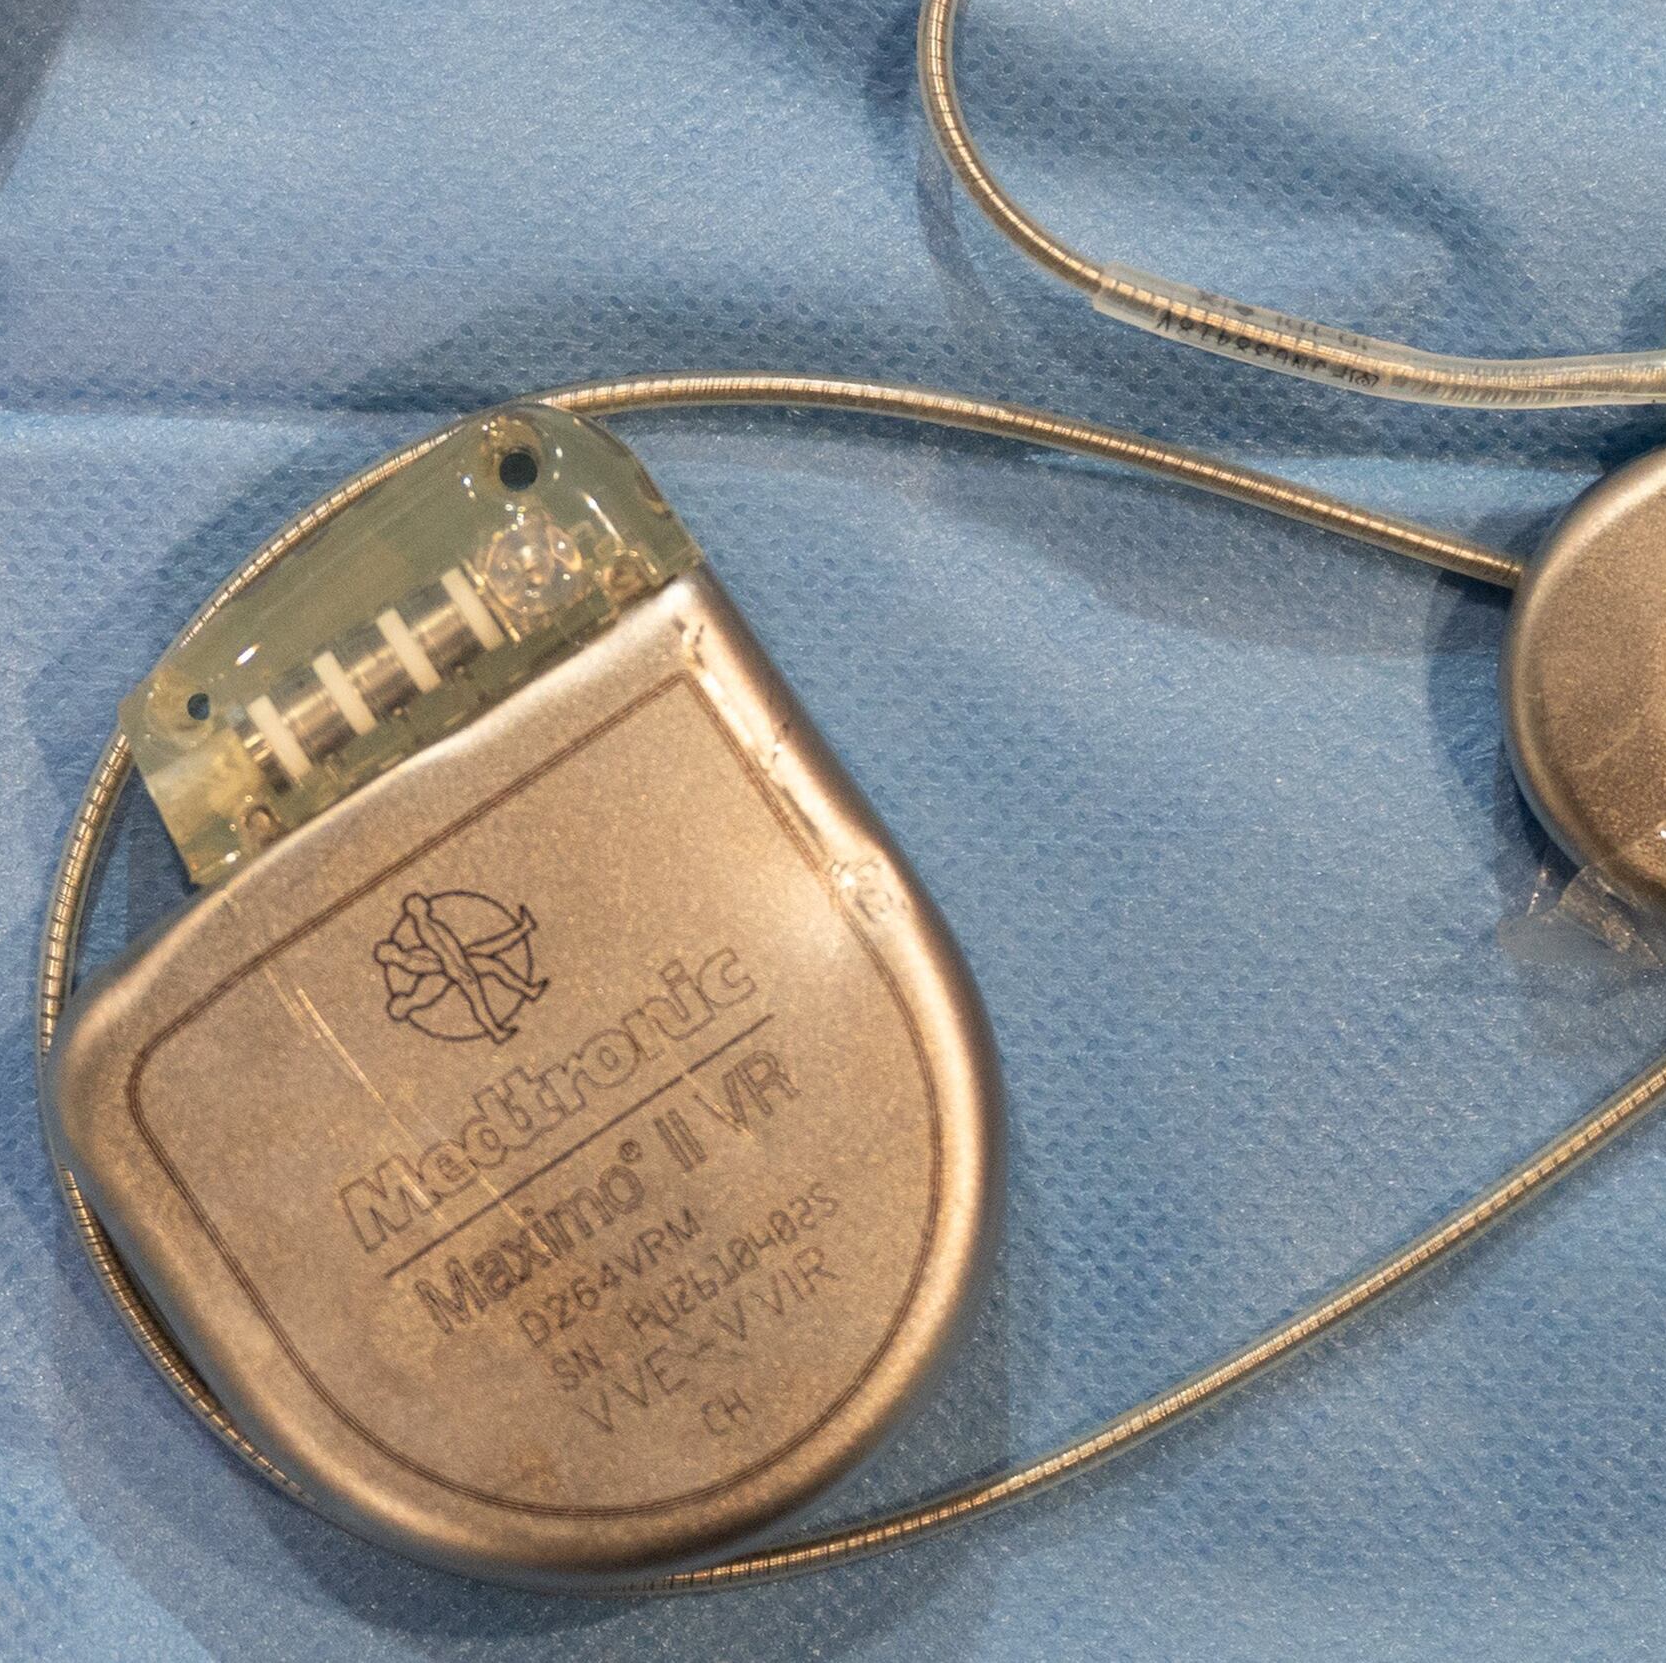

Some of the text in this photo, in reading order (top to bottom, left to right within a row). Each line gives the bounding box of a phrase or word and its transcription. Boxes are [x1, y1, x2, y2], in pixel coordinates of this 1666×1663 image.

[338, 946, 758, 1254] Medtronic
[653, 1108, 708, 1172] II
[694, 1049, 802, 1139] VR
[518, 1206, 703, 1349] D264VRM
[551, 1338, 606, 1394] SN
